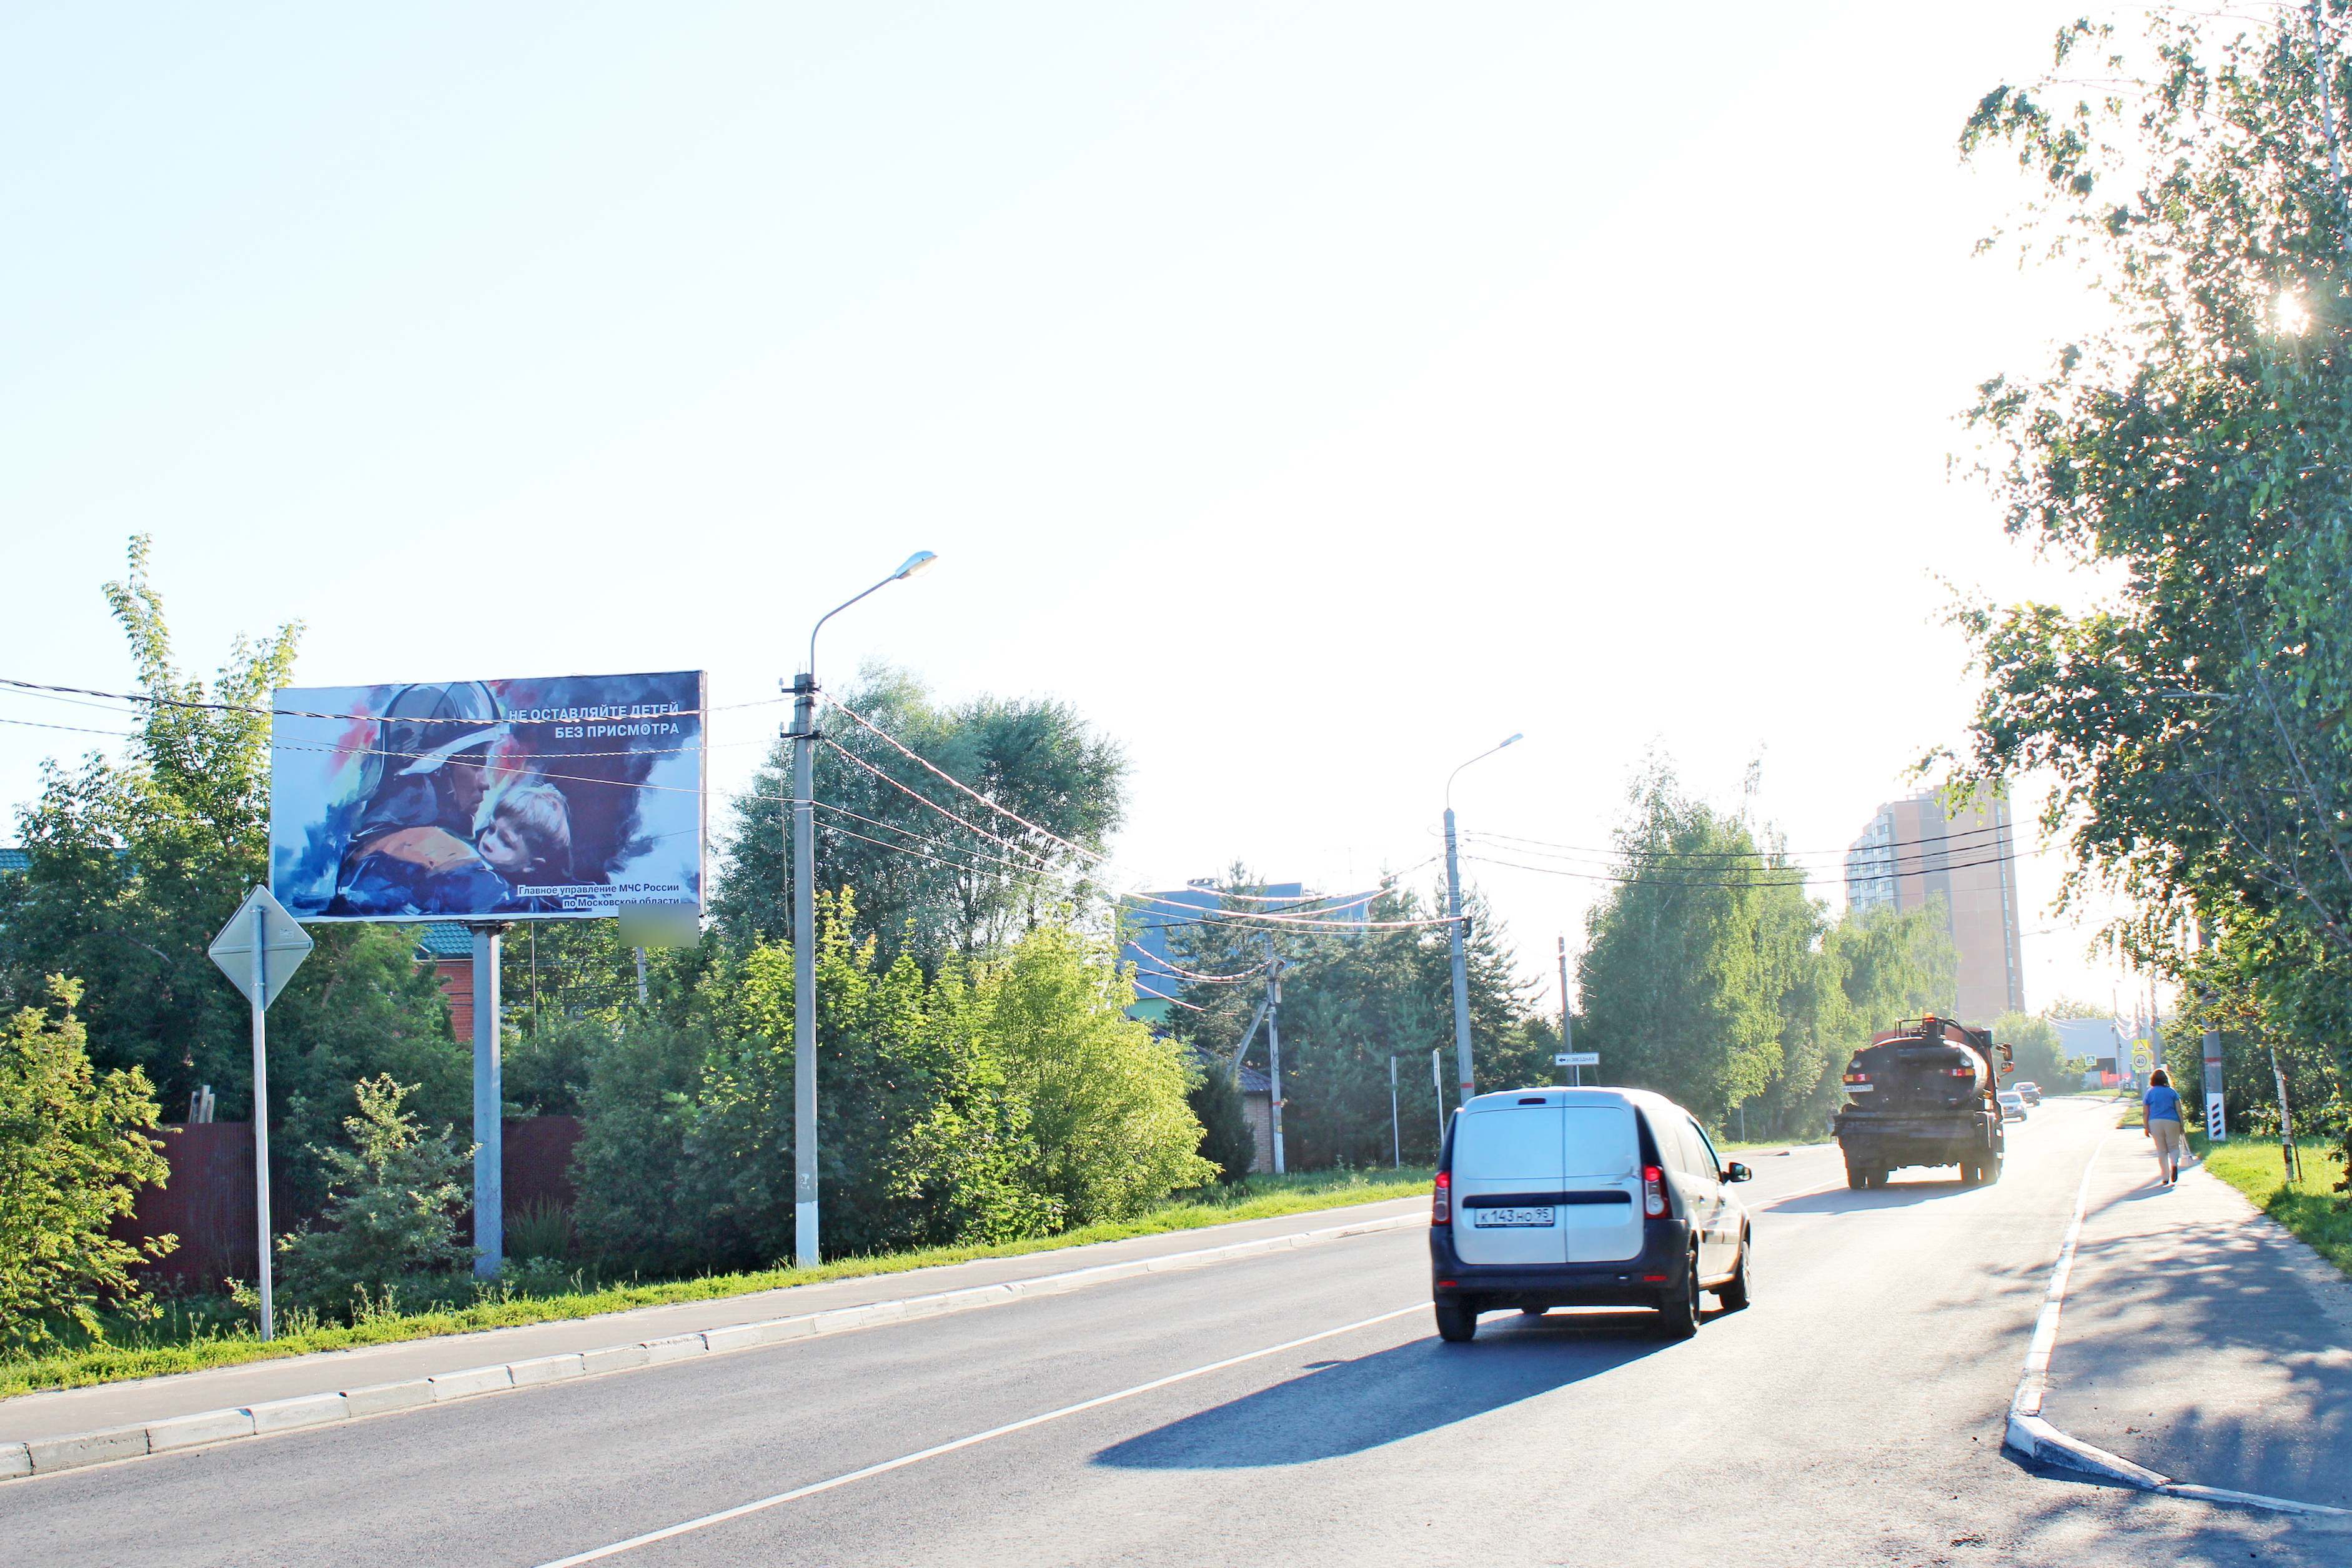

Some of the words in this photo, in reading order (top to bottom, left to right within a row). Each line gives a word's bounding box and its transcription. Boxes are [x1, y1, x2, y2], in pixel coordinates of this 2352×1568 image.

[509, 710, 527, 721] НЕ
[530, 704, 627, 720] ОСТАВЛЯЙТЕ
[630, 702, 679, 717] ДЕТЕЙ
[555, 727, 583, 738] БЕЗ
[587, 723, 680, 737] ПРИСМОТРА
[519, 886, 557, 895] Главное
[560, 885, 617, 896] управление
[619, 884, 641, 892] МЧС
[643, 883, 679, 891] России
[578, 898, 637, 906] Московской
